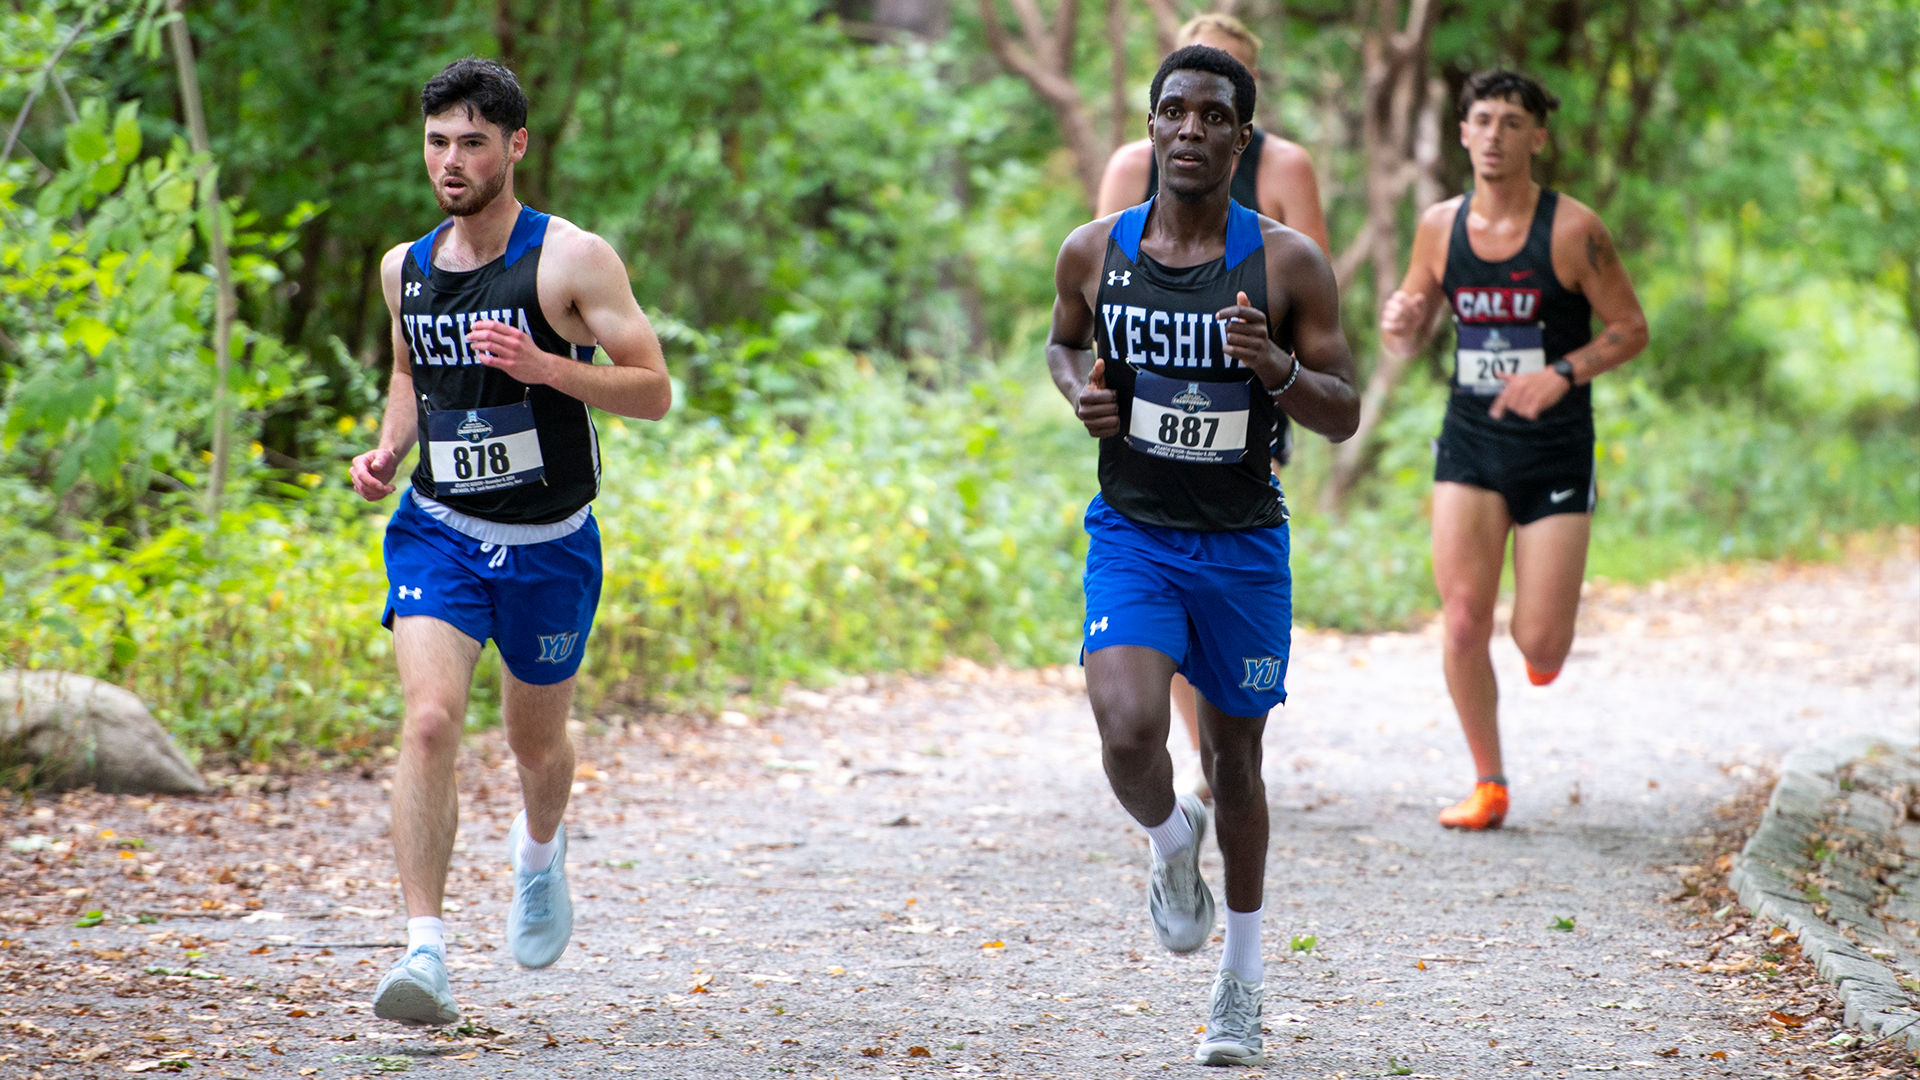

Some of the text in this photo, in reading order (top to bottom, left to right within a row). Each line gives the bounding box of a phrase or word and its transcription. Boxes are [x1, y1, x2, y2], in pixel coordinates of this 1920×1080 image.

[1456, 291, 1535, 319] CAL U
[403, 308, 534, 365] YESHA
[1102, 304, 1248, 368] YESHIV
[1476, 357, 1520, 380] 207
[1158, 413, 1219, 448] 887
[453, 442, 510, 480] 878
[535, 631, 579, 664] YU
[1239, 655, 1283, 691] YU
